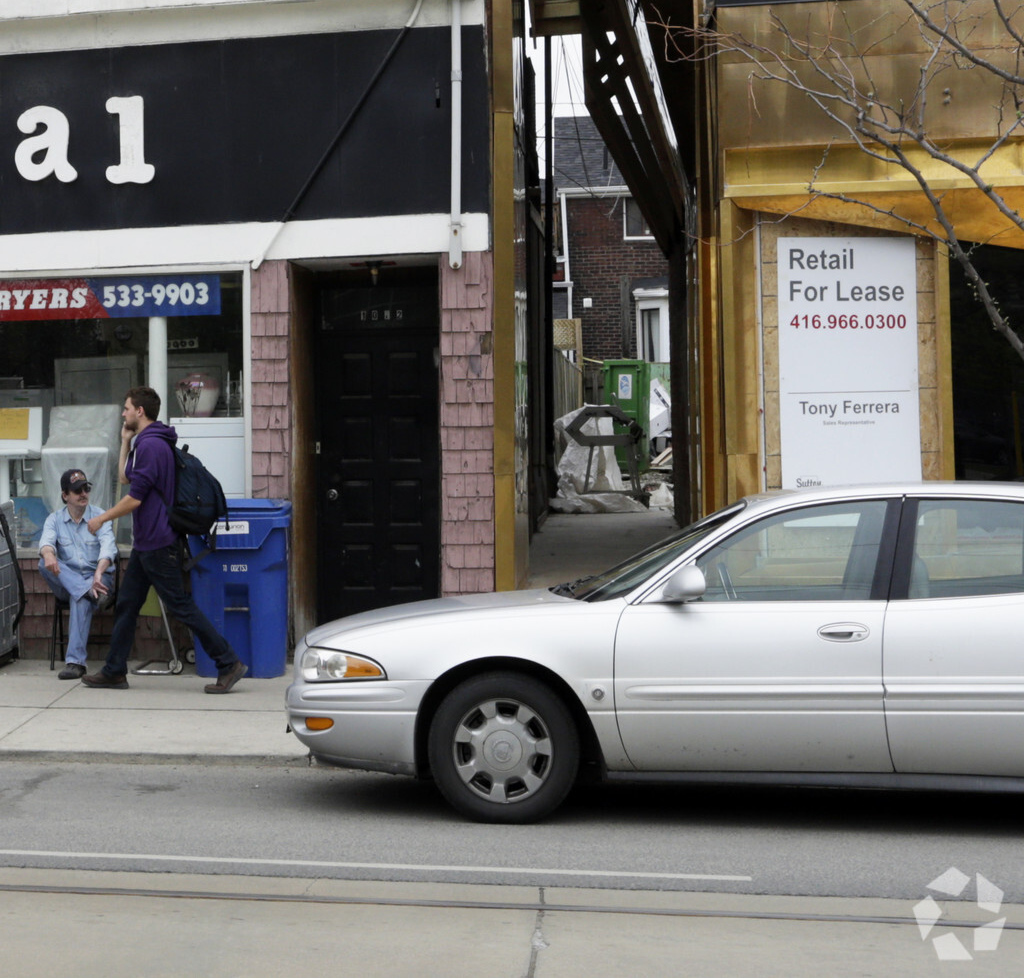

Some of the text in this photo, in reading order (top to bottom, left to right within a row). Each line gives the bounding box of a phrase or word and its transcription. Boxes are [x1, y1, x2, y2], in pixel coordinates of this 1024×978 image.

[789, 248, 855, 270] Retail
[103, 282, 209, 308] 533-9903
[789, 280, 905, 302] For Lease
[790, 314, 907, 330] 416.966.0300
[799, 400, 900, 418] Tony Ferrera
[837, 419, 876, 427] Representative
